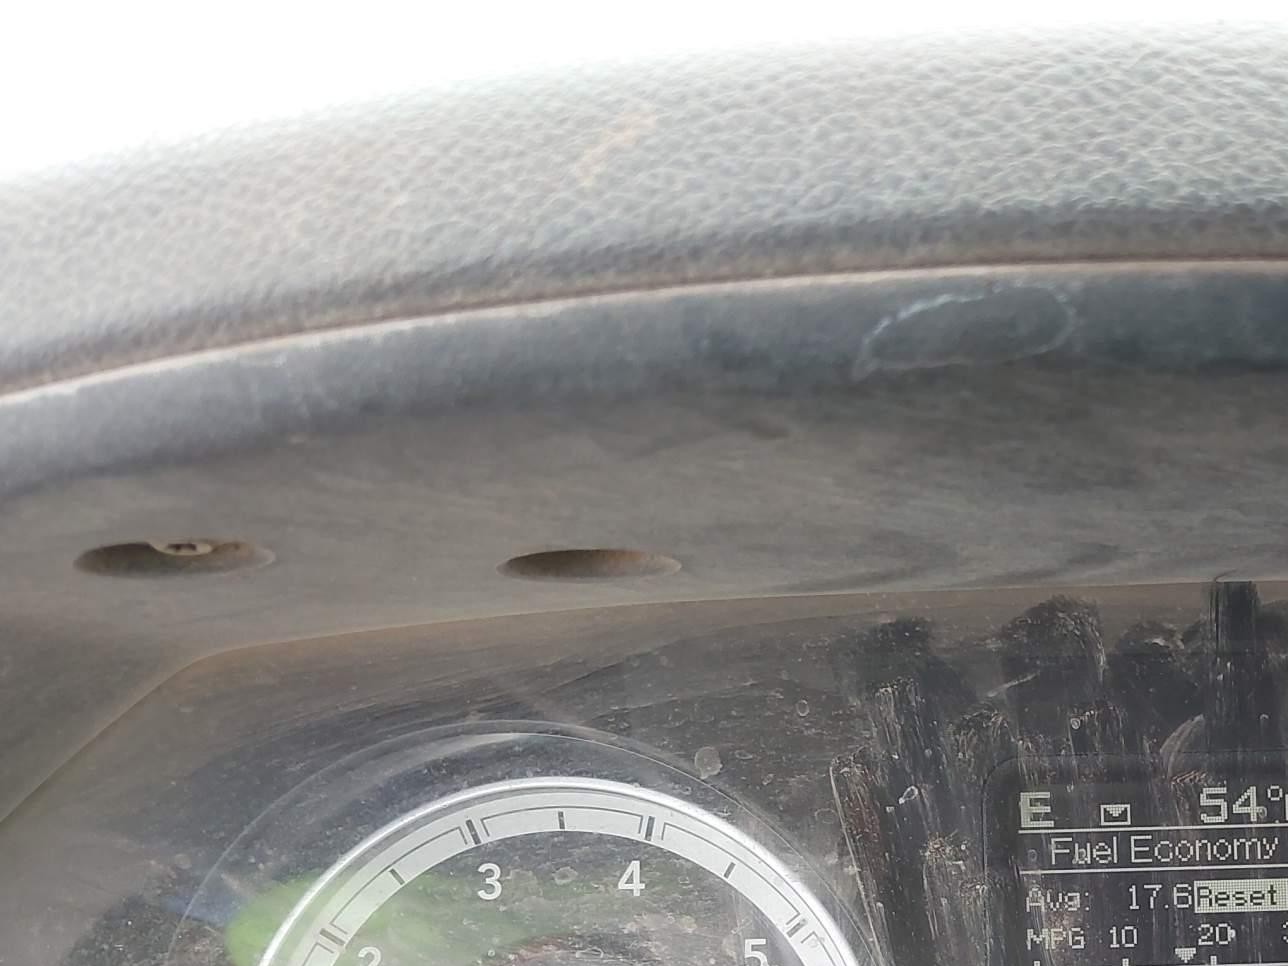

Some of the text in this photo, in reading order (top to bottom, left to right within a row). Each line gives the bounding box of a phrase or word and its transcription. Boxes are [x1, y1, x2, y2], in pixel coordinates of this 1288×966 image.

[1020, 792, 1054, 827] E
[1051, 835, 1279, 865] Fuel Economy
[477, 864, 501, 900] 3
[618, 860, 646, 896] 4
[1026, 883, 1278, 912] Avg: 17.6 Reset
[1027, 927, 1085, 950] MPG
[1109, 925, 1138, 948] 10
[1198, 923, 1230, 945] 20
